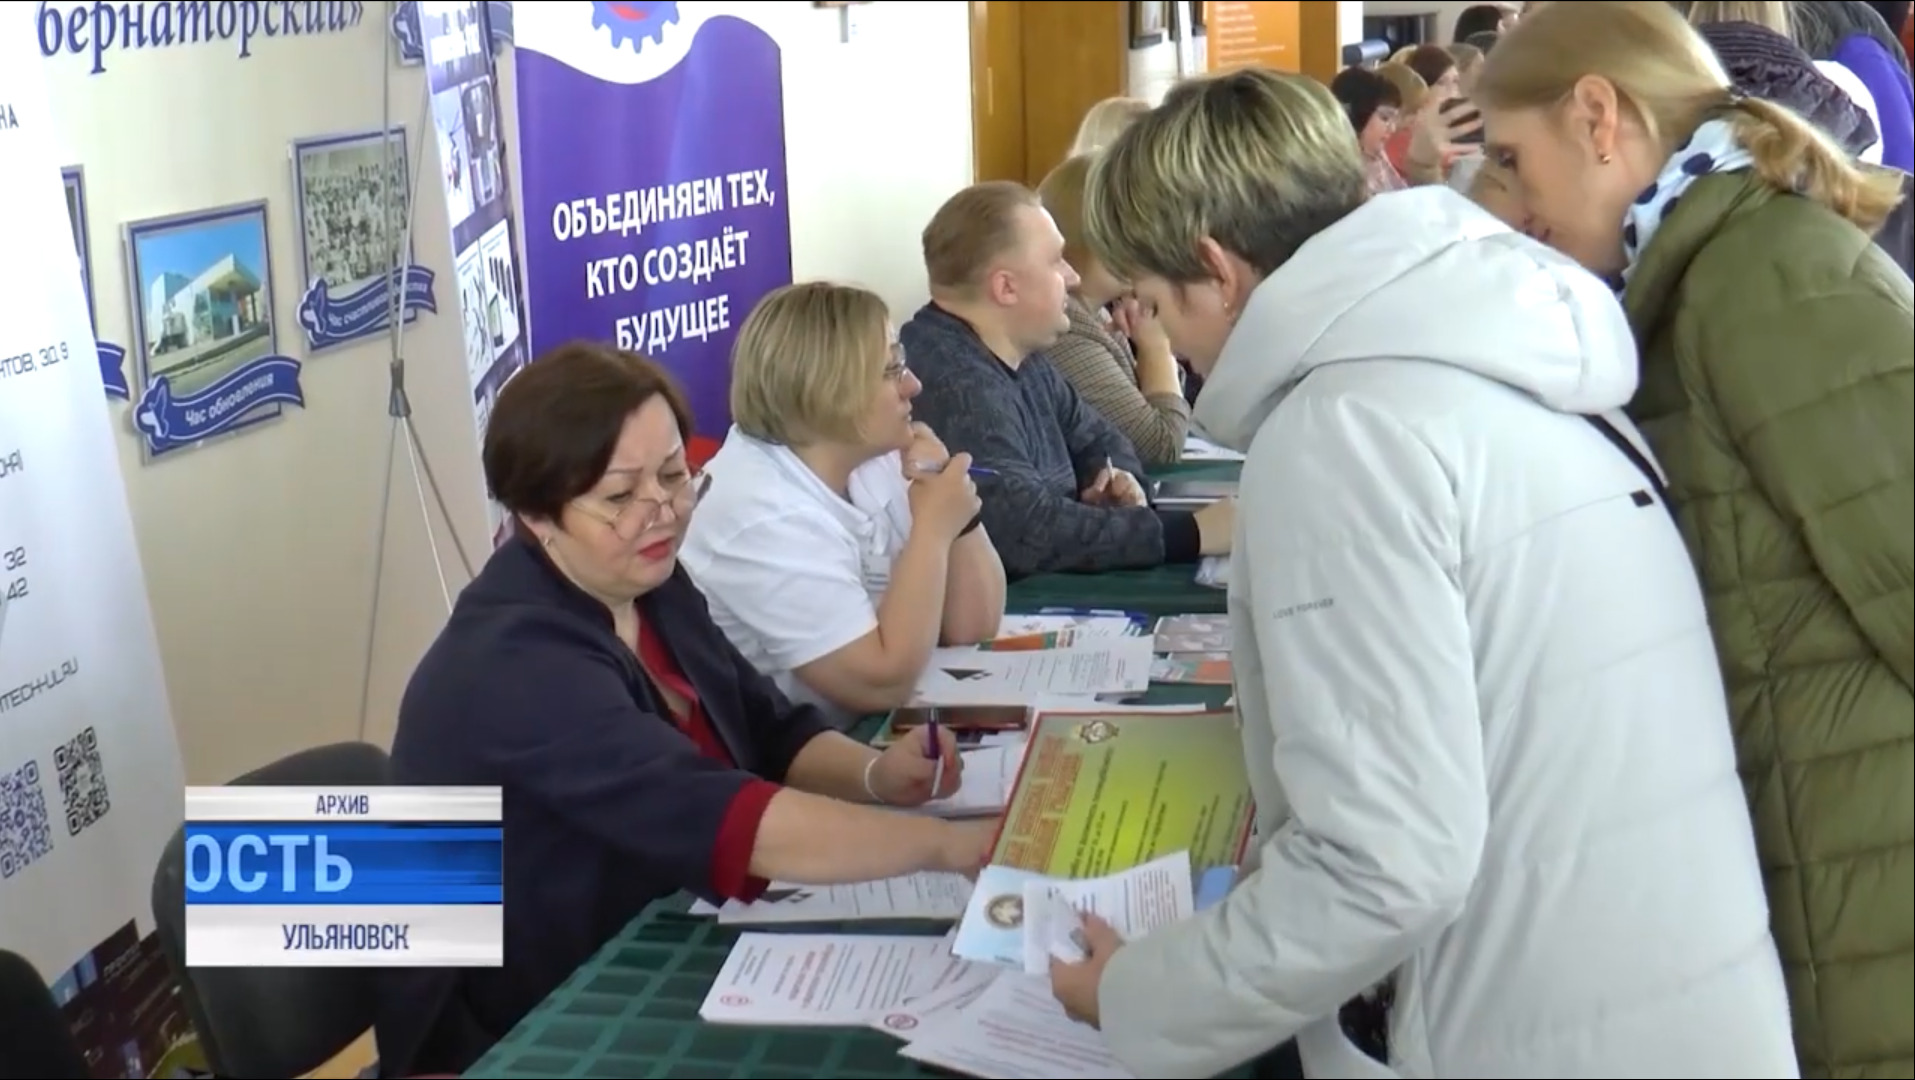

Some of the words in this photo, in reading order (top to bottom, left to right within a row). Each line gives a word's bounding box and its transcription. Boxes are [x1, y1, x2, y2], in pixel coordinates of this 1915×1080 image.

[553, 176, 724, 241] ОБЪЕДИНЯЕМ
[726, 168, 775, 207] ТЕХ,
[586, 254, 639, 299] КТО
[643, 225, 749, 285] СОЗДАЁТ
[615, 294, 730, 356] БУДУЩЕЕ
[185, 408, 207, 426] Час
[208, 373, 274, 419] обновления
[3, 546, 27, 571] 32
